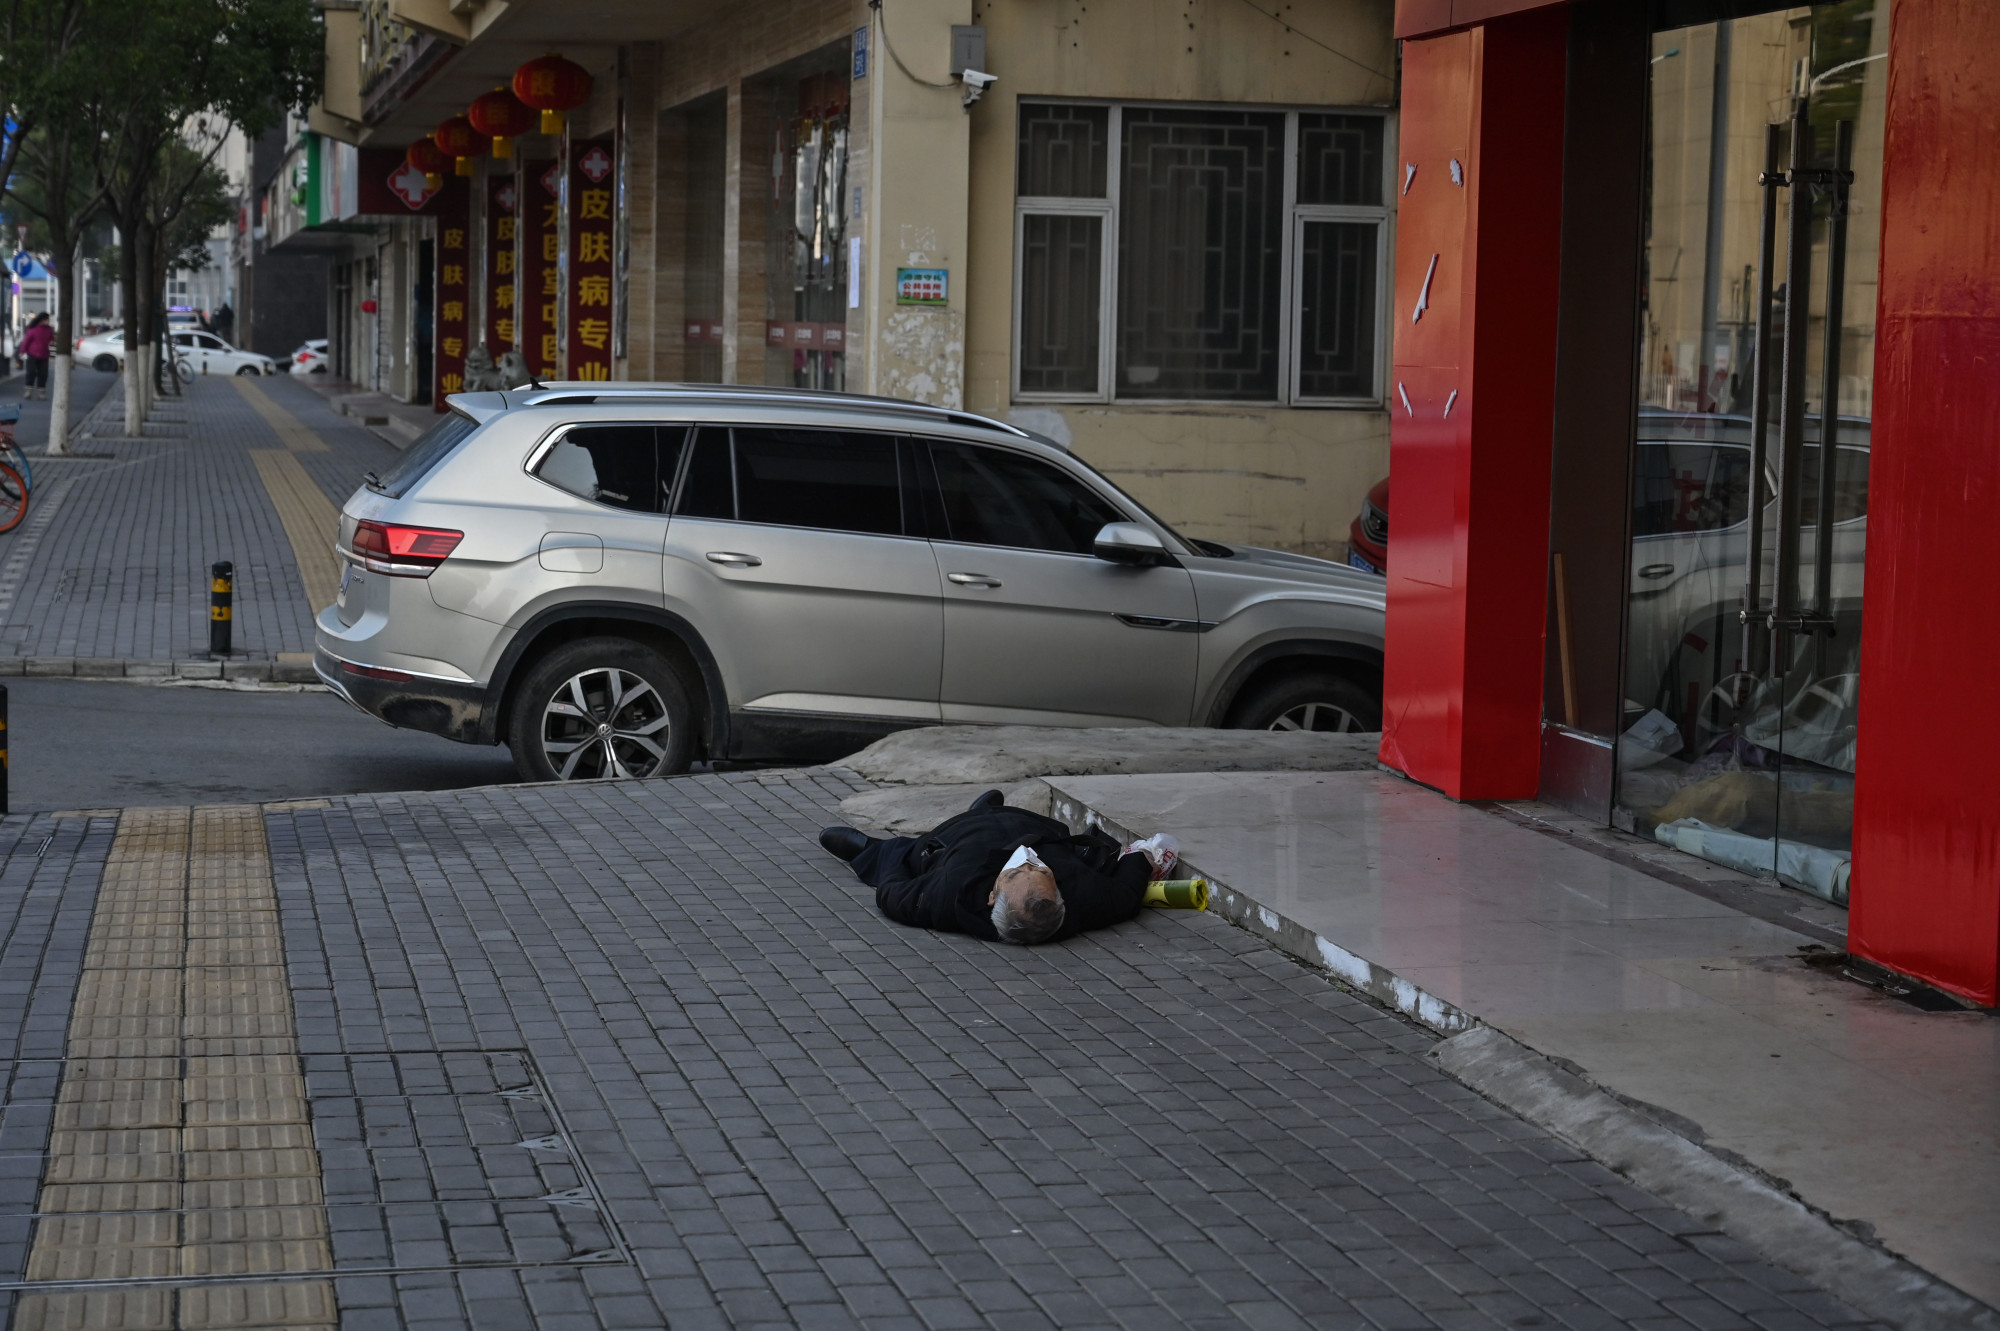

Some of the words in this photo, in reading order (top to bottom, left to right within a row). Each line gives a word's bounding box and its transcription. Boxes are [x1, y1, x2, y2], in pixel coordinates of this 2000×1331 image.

[441, 228, 464, 393] 皮肤病专业
[495, 216, 514, 366] 皮肤病专
[577, 188, 610, 380] 皮肤病专业
